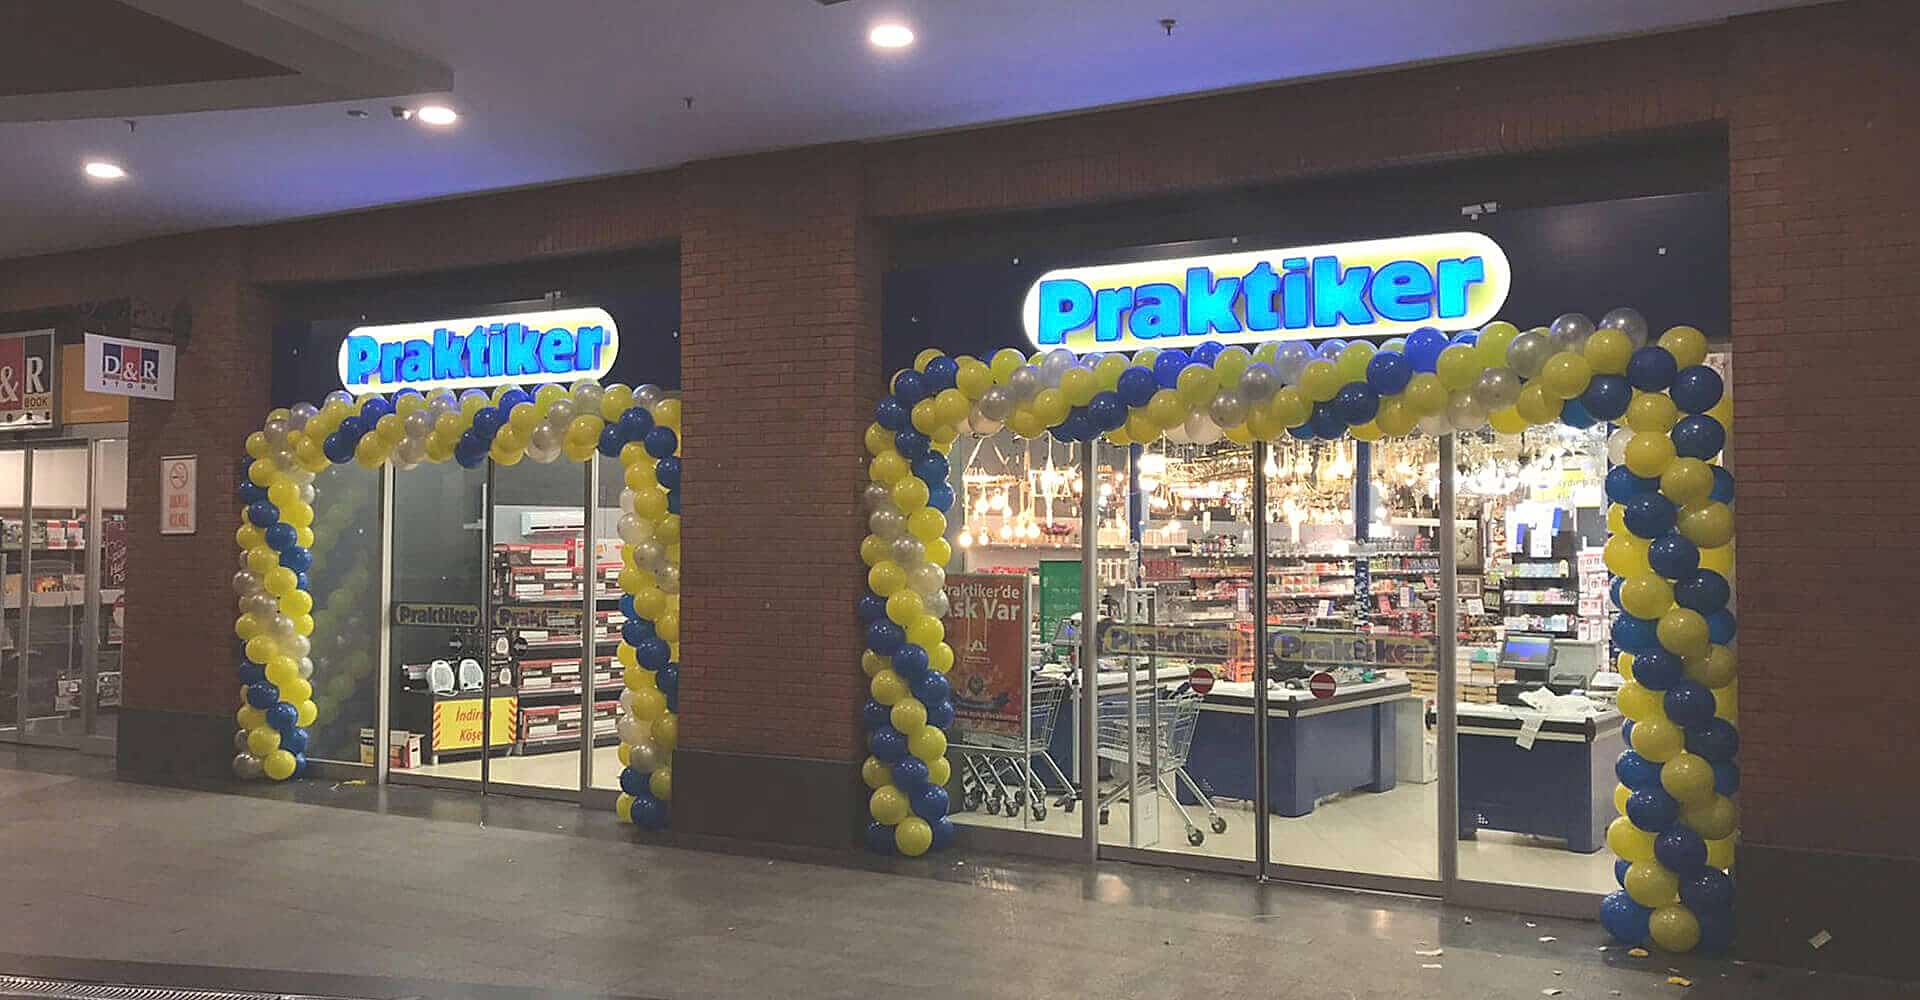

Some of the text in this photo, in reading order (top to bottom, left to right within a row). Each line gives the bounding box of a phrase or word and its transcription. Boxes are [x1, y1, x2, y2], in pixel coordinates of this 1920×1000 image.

[1038, 256, 1485, 344] Praktiker
[347, 323, 606, 385] Praktiker
[104, 354, 157, 381] D&R
[944, 583, 1020, 599] raktiker'de
[400, 606, 478, 625] Praktiker
[983, 599, 1020, 621] Var
